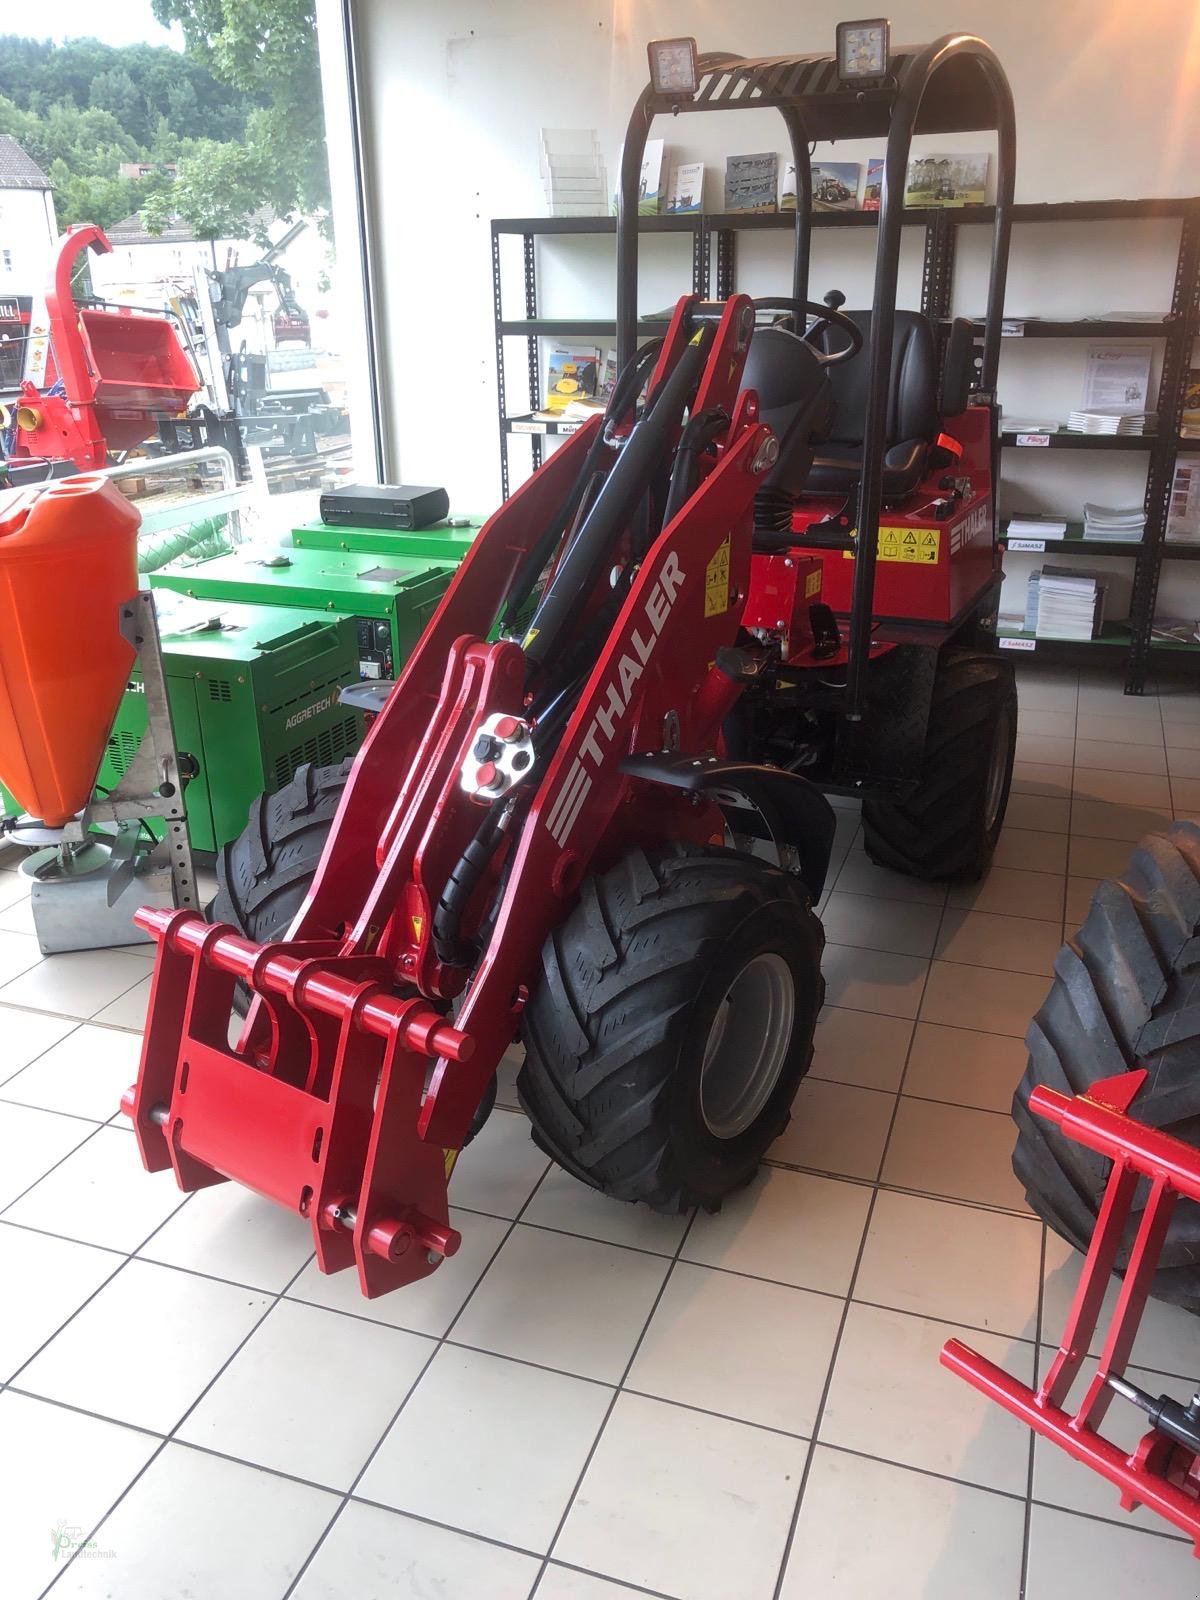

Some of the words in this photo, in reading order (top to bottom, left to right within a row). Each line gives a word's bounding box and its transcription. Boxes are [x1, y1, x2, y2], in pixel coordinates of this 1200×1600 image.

[961, 504, 987, 545] THALER
[577, 551, 687, 767] THALER
[285, 695, 331, 730] AGGRETECH
